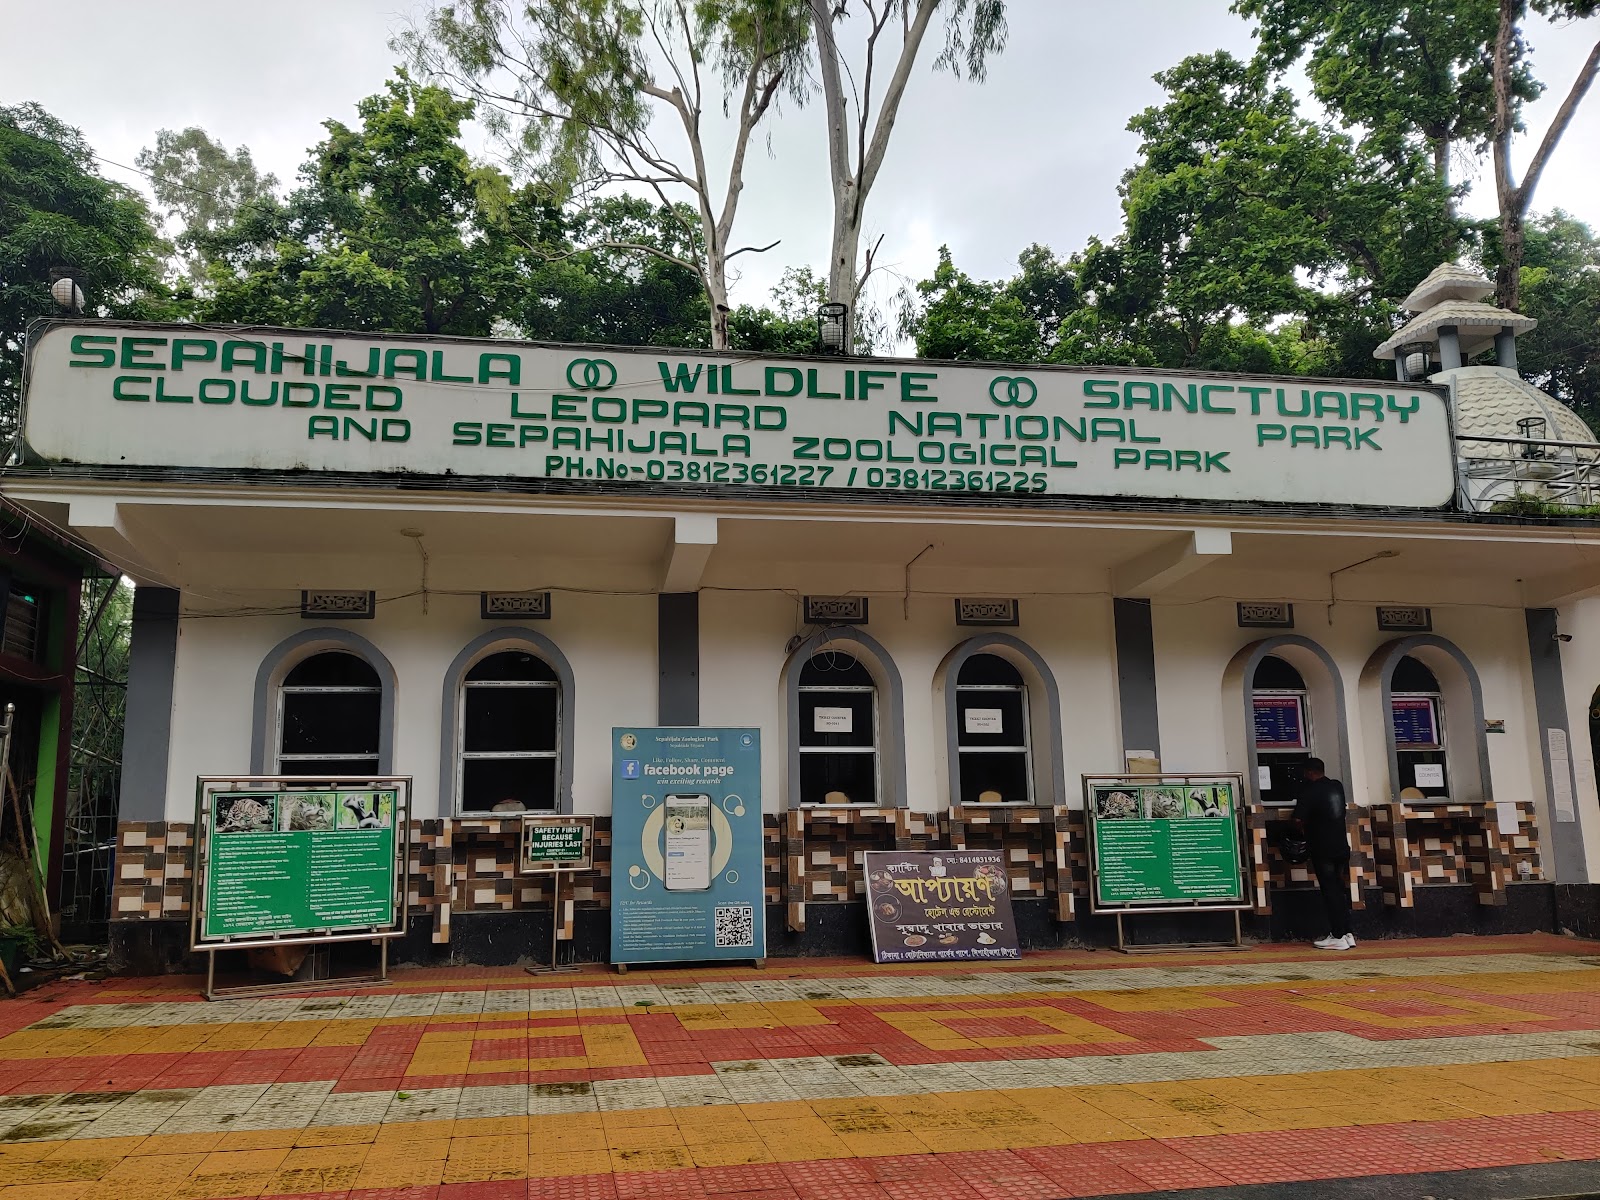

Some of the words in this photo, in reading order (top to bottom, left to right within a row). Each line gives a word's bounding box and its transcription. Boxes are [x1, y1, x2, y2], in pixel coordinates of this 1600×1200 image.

[69, 336, 521, 385] SEPAHIJALA
[658, 362, 937, 401] WILDLIFE
[1084, 380, 1420, 423] SANCTUARY
[113, 376, 402, 412] CLOUDED
[511, 393, 787, 431] LEOPARD
[889, 411, 1162, 442] NATIONAL
[1257, 424, 1380, 450] PARK
[308, 415, 411, 442] AND
[453, 422, 750, 457] SEPAHIJALA
[793, 437, 1077, 467] ZOOLOGICAL
[1115, 449, 1229, 472] PARK
[867, 468, 1048, 493] 03812361225
[643, 763, 700, 775] facebook
[703, 766, 734, 777] page
[670, 777, 694, 786] exciting
[695, 777, 721, 785] rewards
